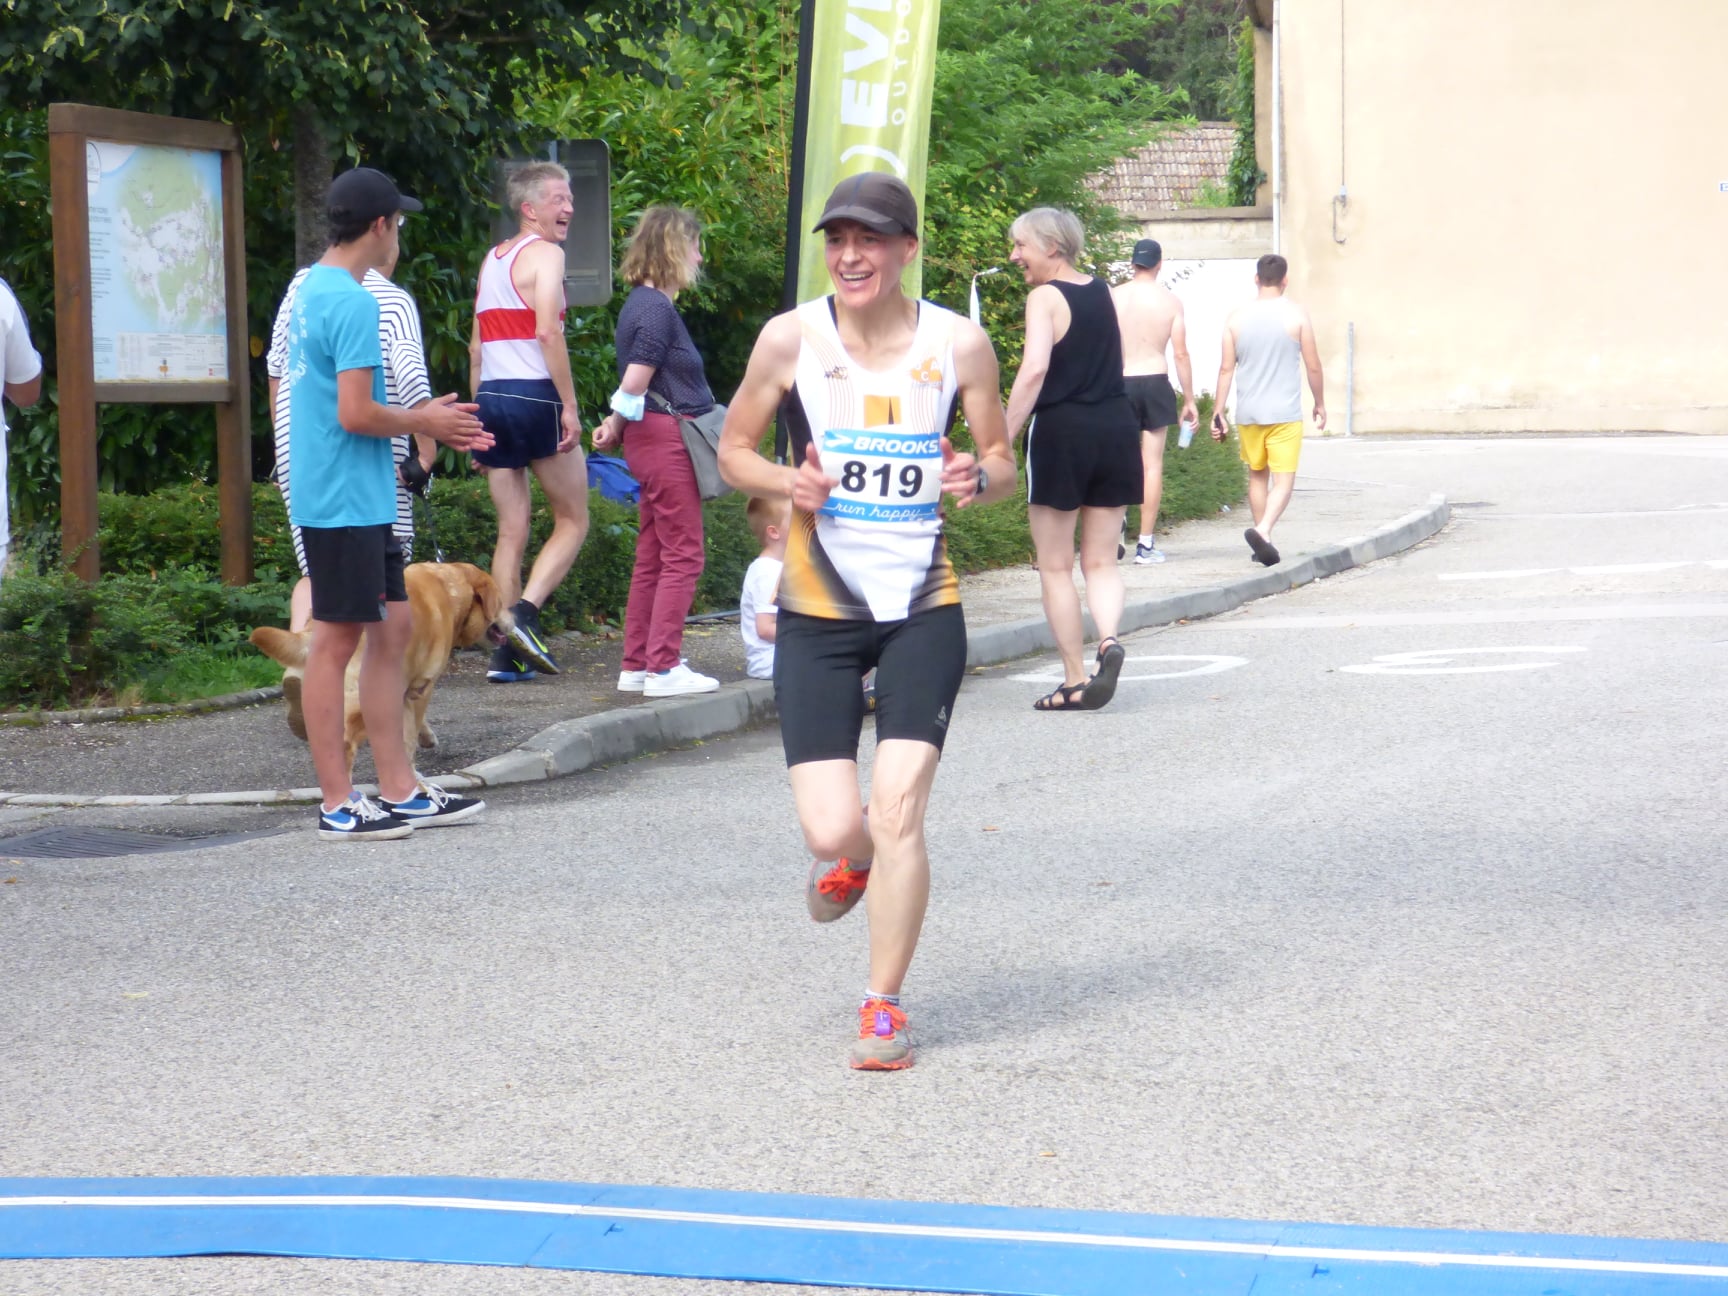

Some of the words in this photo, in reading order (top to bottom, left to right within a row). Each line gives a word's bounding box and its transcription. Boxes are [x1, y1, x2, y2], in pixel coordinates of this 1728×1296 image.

[853, 436, 939, 454] BROOKS
[841, 460, 923, 498] 819
[831, 502, 866, 516] run
[868, 504, 925, 521] happy
